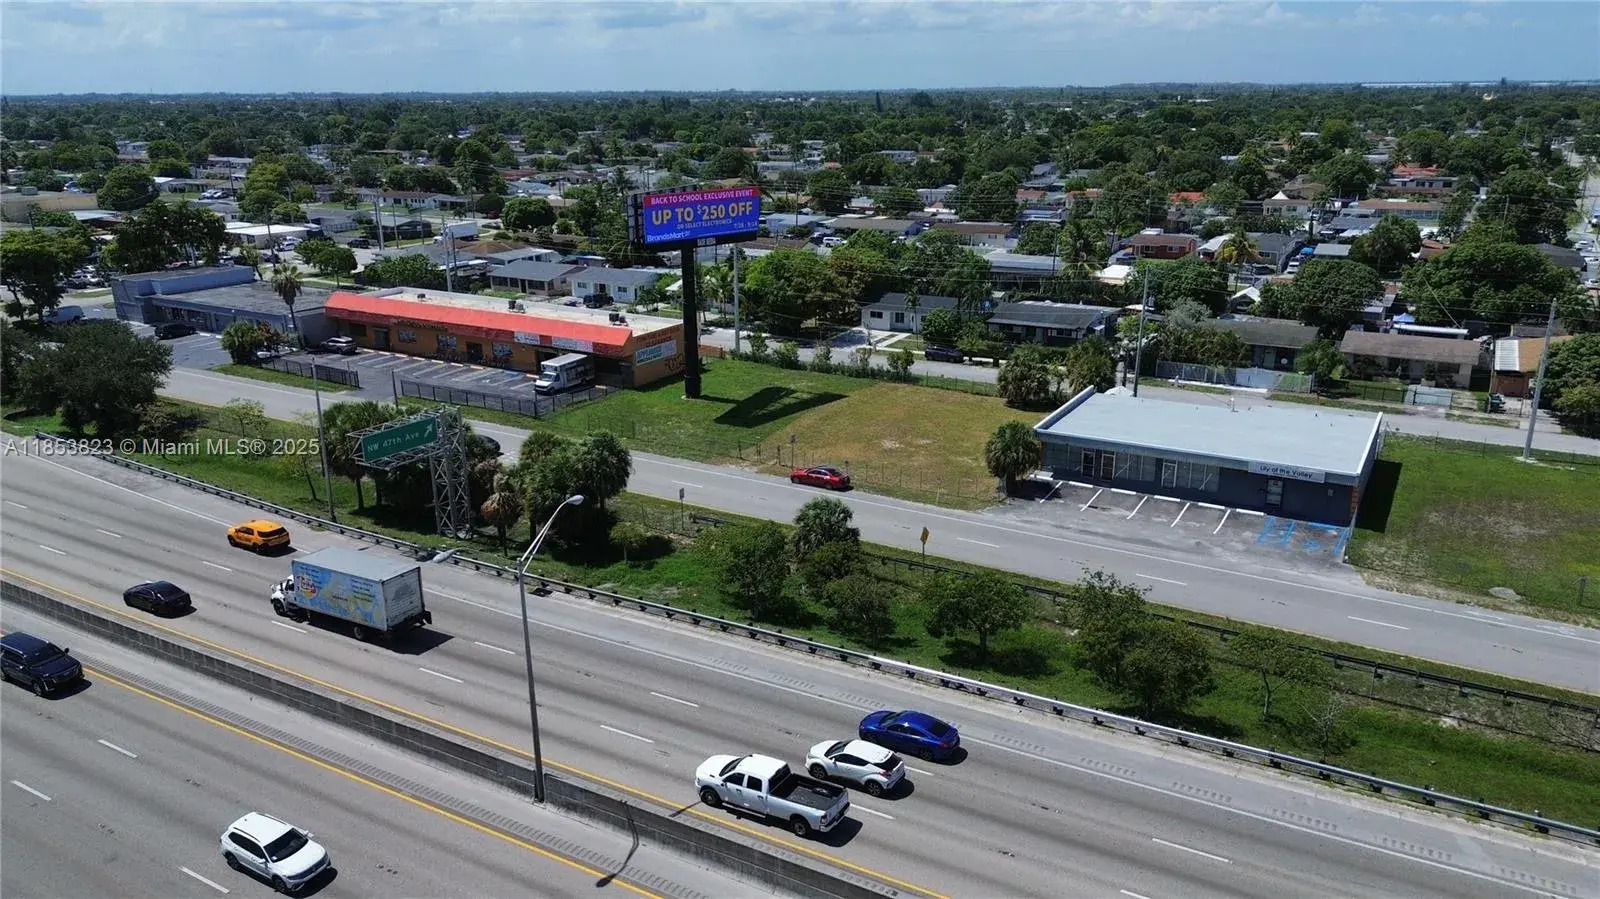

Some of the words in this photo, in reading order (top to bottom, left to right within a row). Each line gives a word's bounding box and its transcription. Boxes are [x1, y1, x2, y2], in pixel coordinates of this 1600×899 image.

[651, 196, 668, 205] BACK
[669, 195, 678, 203] TO
[678, 193, 703, 202] SCHOOL
[703, 190, 735, 200] EXCLUSIVE
[735, 189, 753, 197] EVENT
[652, 209, 672, 225] UP
[675, 207, 694, 223] TO
[697, 204, 726, 221] $250
[728, 201, 753, 217] OFF
[685, 221, 702, 229] SELECT
[647, 232, 685, 241] BrandsMart
[367, 442, 379, 452] NW
[382, 437, 402, 447] 47th
[405, 432, 420, 441] Ave
[1292, 469, 1313, 479] Valley
